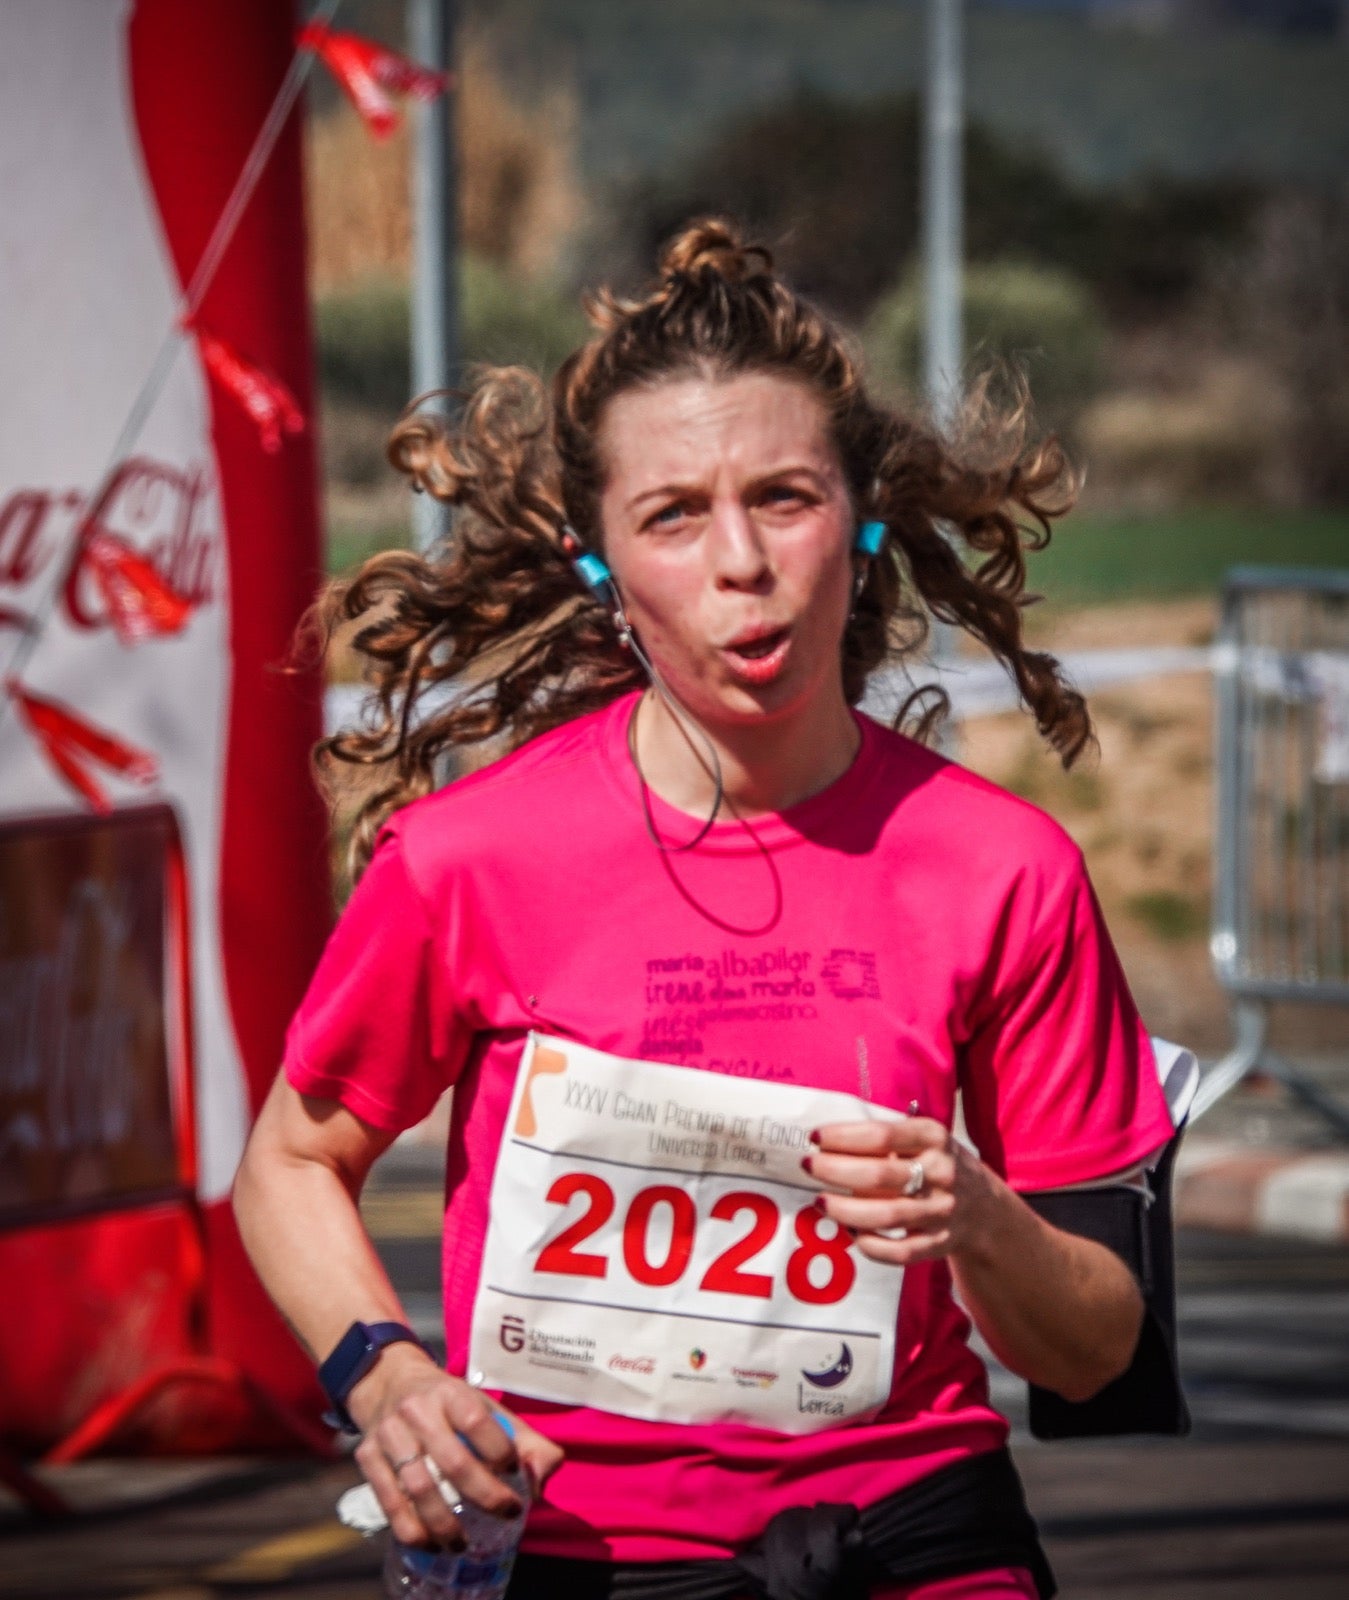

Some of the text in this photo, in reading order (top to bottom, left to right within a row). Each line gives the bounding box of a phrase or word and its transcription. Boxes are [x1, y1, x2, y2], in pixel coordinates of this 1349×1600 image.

[706, 950, 763, 979] alba
[563, 1079, 608, 1114] XXXV
[533, 1172, 857, 1307] 2028
